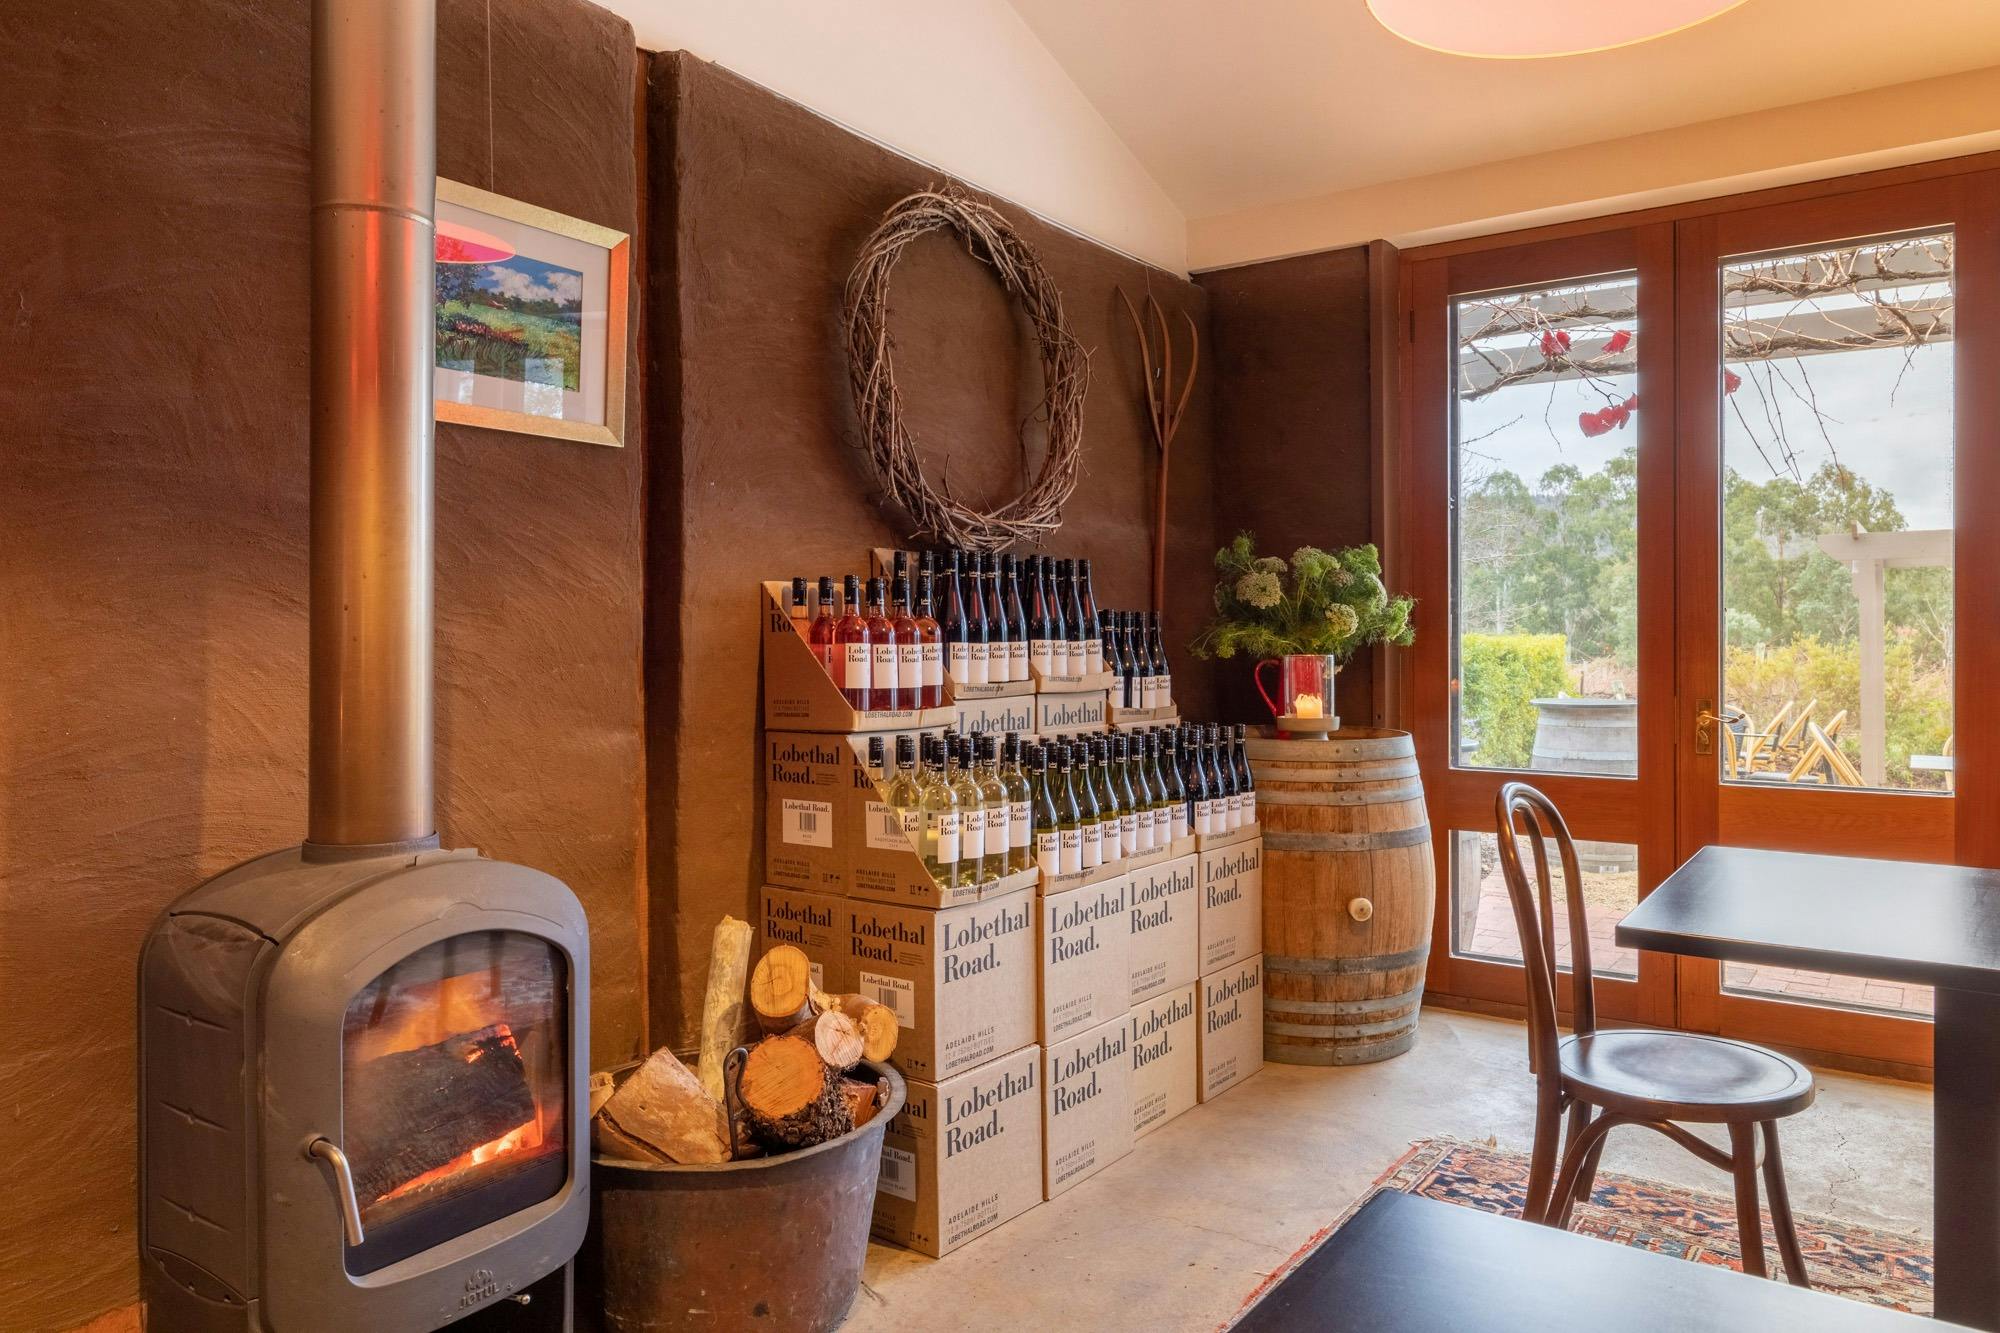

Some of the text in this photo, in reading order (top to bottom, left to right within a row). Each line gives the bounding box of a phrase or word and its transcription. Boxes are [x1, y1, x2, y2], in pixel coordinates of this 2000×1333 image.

[959, 706, 1031, 735] Lobethal
[1043, 700, 1103, 727] Lobethal
[772, 742, 840, 765] Lobethal
[772, 763, 815, 785] Road.
[785, 802, 811, 811] Lobethal
[1206, 847, 1259, 883] Lobethal
[1130, 866, 1194, 906] Lobethal
[1206, 879, 1242, 909] Road.
[767, 897, 832, 927] Lobethal
[943, 902, 1029, 952] Lobethal
[1050, 887, 1125, 934] Lobethal
[1130, 900, 1173, 935] Road.
[767, 919, 808, 945] Road.
[851, 914, 926, 945] Lobethal
[1050, 925, 1100, 965] Road.
[851, 937, 898, 964] Road.
[943, 942, 1001, 985] Road.
[862, 974, 912, 991] Lobethal Road.
[1207, 964, 1259, 1009] Lobethal
[1132, 992, 1193, 1042] Lobethal
[1207, 999, 1242, 1034] Road.
[945, 1033, 976, 1051] ADELAIDE
[978, 1026, 994, 1038] HILLS
[1132, 1031, 1173, 1071] Road.
[945, 1045, 994, 1070] LOBETHALROAD.COM
[1052, 1027, 1127, 1086] Lobethal
[945, 1062, 1034, 1127] Lobethal
[1052, 1071, 1102, 1116] Road.
[945, 1109, 1004, 1160] Road.
[948, 1193, 999, 1225] ADELAIDE HILLS
[948, 1212, 999, 1245] LOBETHALROAD.COM
